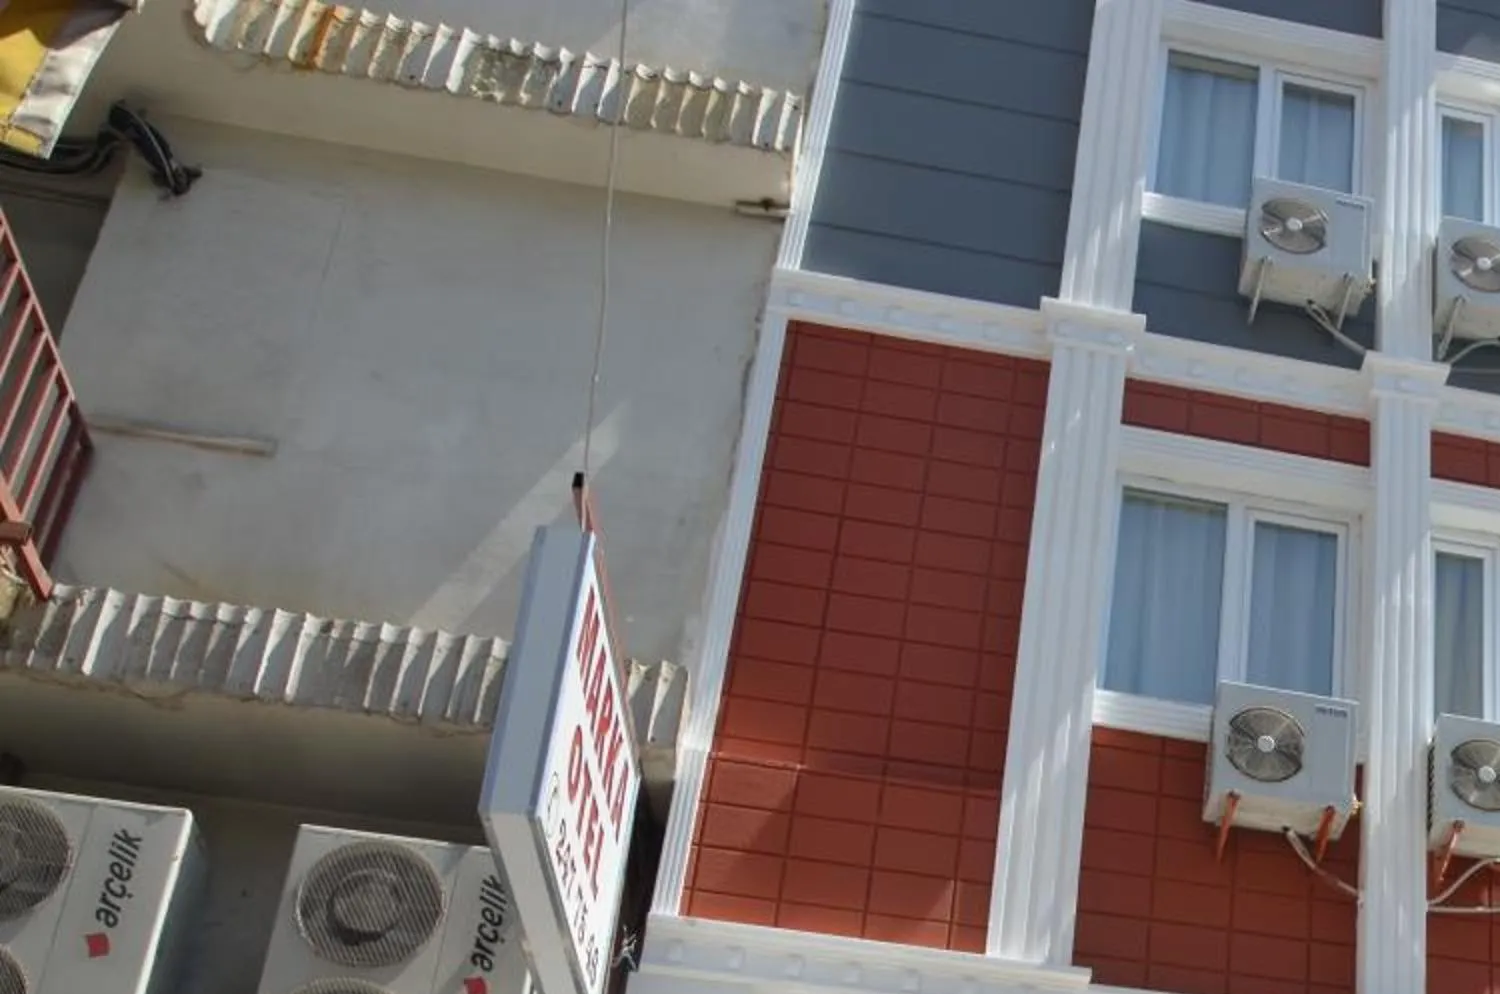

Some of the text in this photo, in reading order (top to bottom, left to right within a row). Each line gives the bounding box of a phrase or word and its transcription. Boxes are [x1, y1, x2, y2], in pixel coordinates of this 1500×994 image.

[576, 583, 630, 843] MARKA
[95, 828, 143, 929] arçelik
[567, 723, 605, 901] OTEL
[470, 874, 507, 972] arçelik
